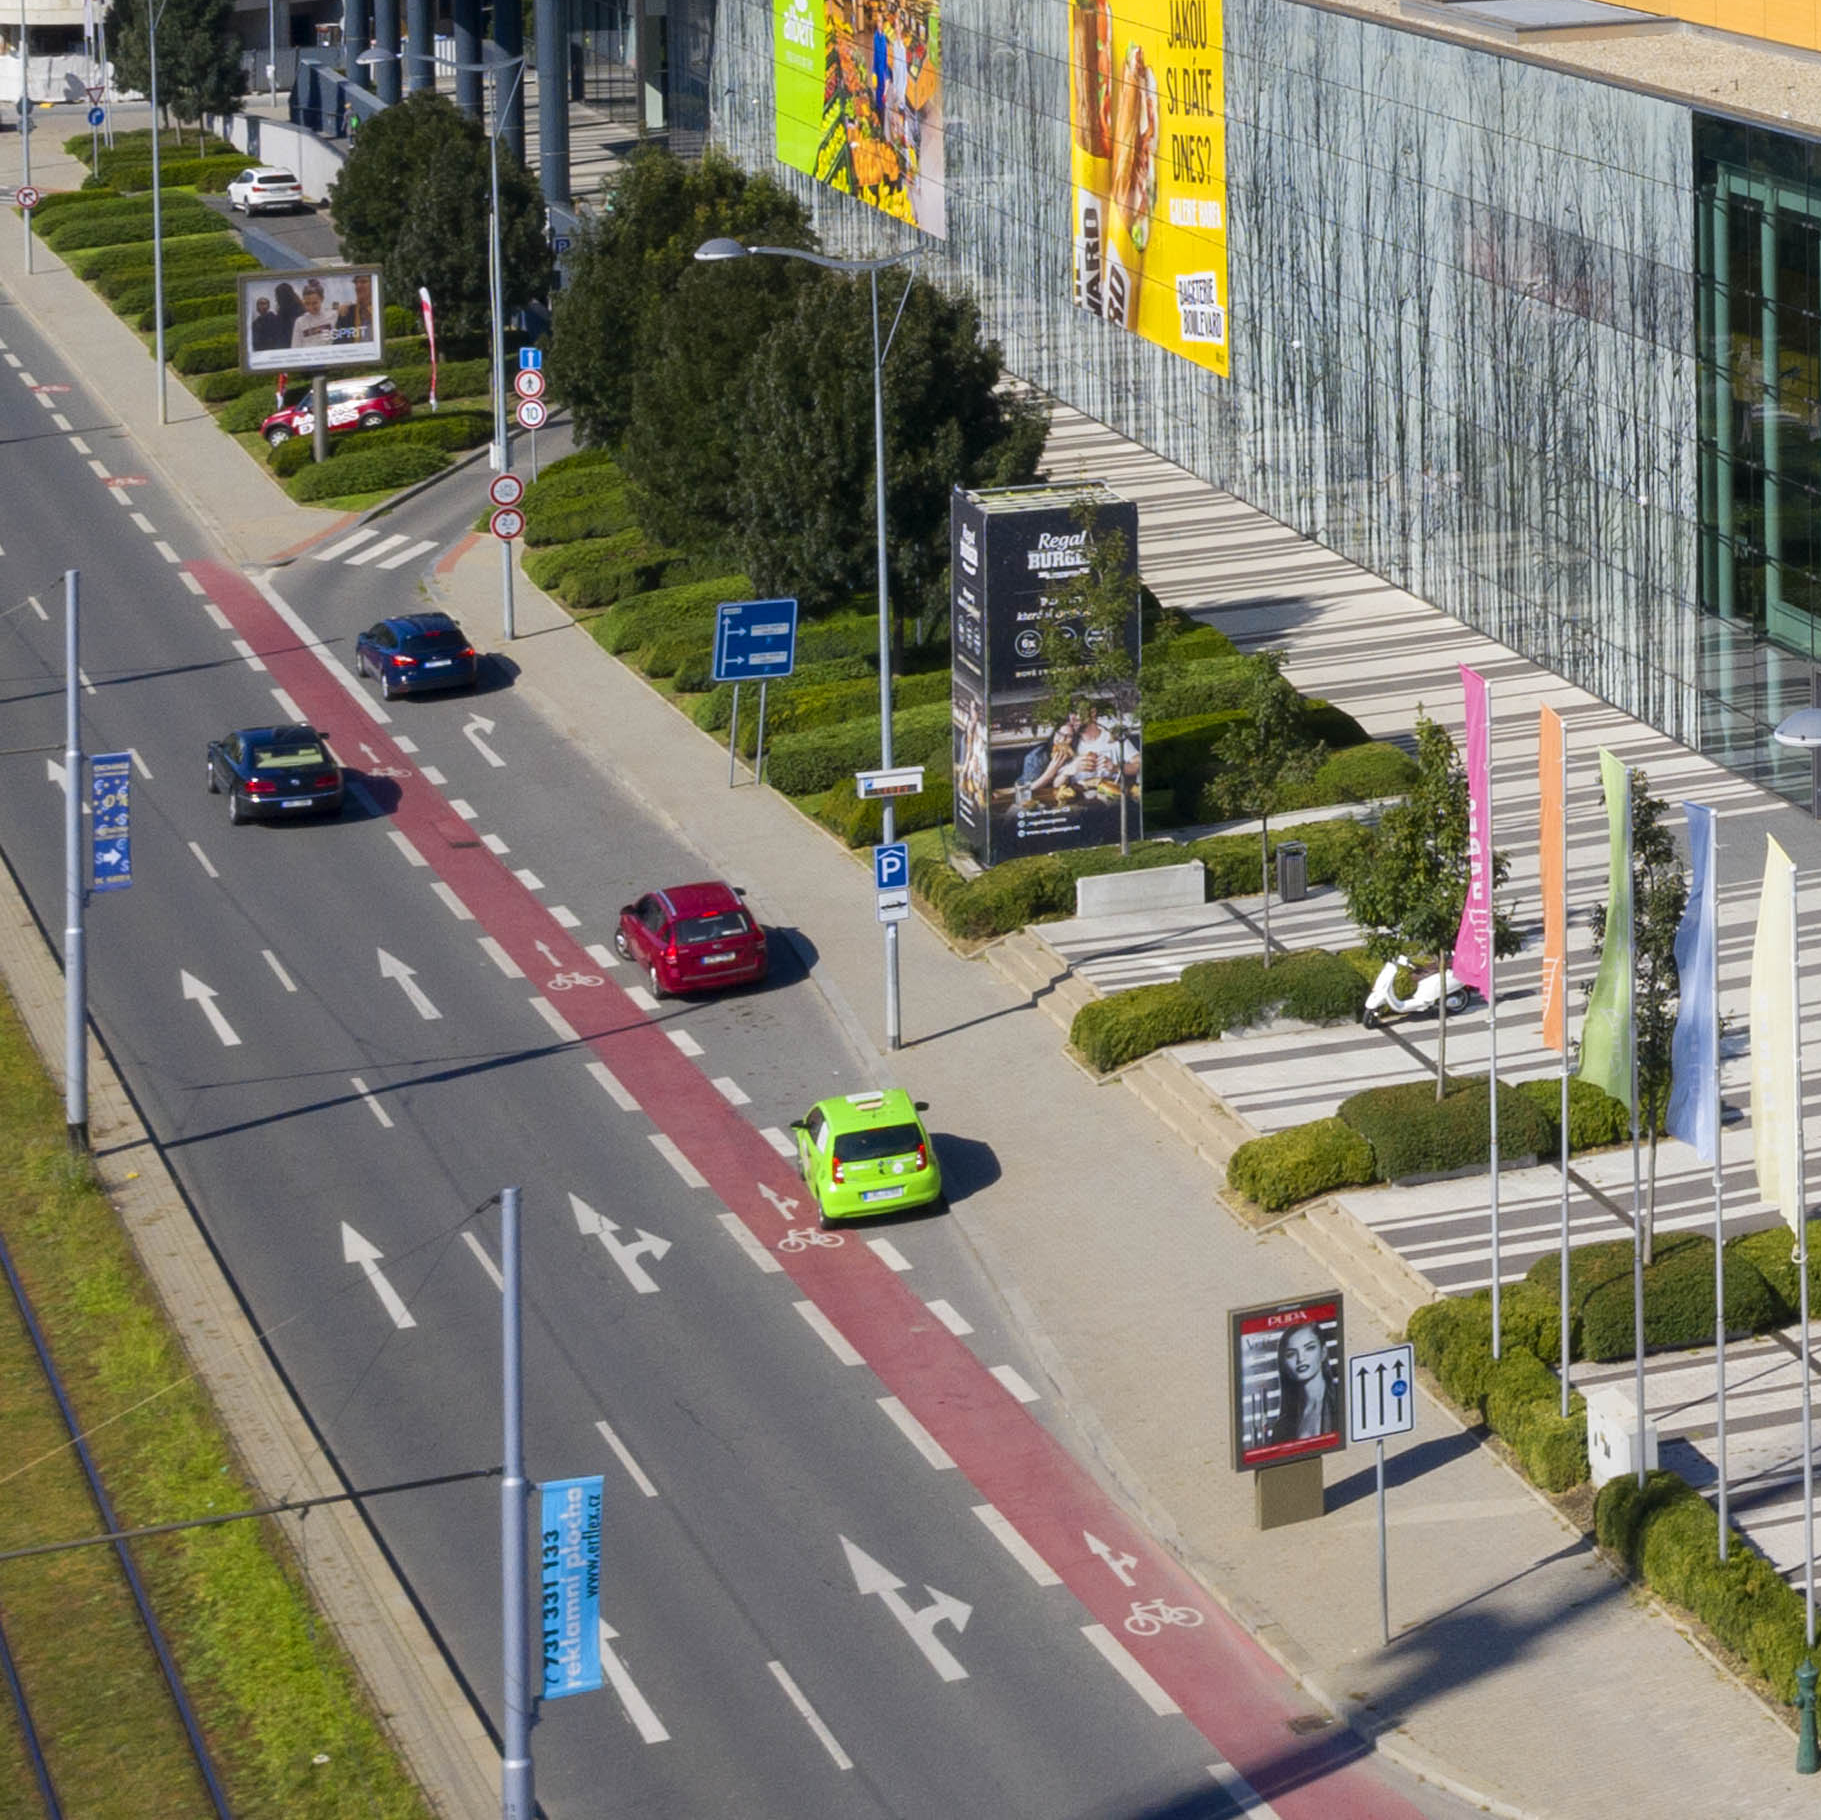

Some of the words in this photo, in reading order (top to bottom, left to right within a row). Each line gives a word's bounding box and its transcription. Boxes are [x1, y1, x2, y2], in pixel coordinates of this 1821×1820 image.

[1167, 0, 1207, 49] JAKOU
[1166, 67, 1179, 115] SI
[1182, 56, 1214, 117] DÁTE
[1172, 134, 1212, 185] DNES?
[325, 326, 368, 340] ESPRIT
[1183, 308, 1222, 338] BOULEVARD
[525, 405, 538, 421] 10
[1027, 548, 1092, 570] BURGE
[1038, 530, 1087, 551] Regal
[881, 857, 902, 884] P
[560, 1486, 588, 1570] plocha
[543, 1529, 560, 1568] 133
[543, 1580, 560, 1622] 331
[543, 1628, 560, 1667] 731
[560, 1574, 583, 1689] reklamní
